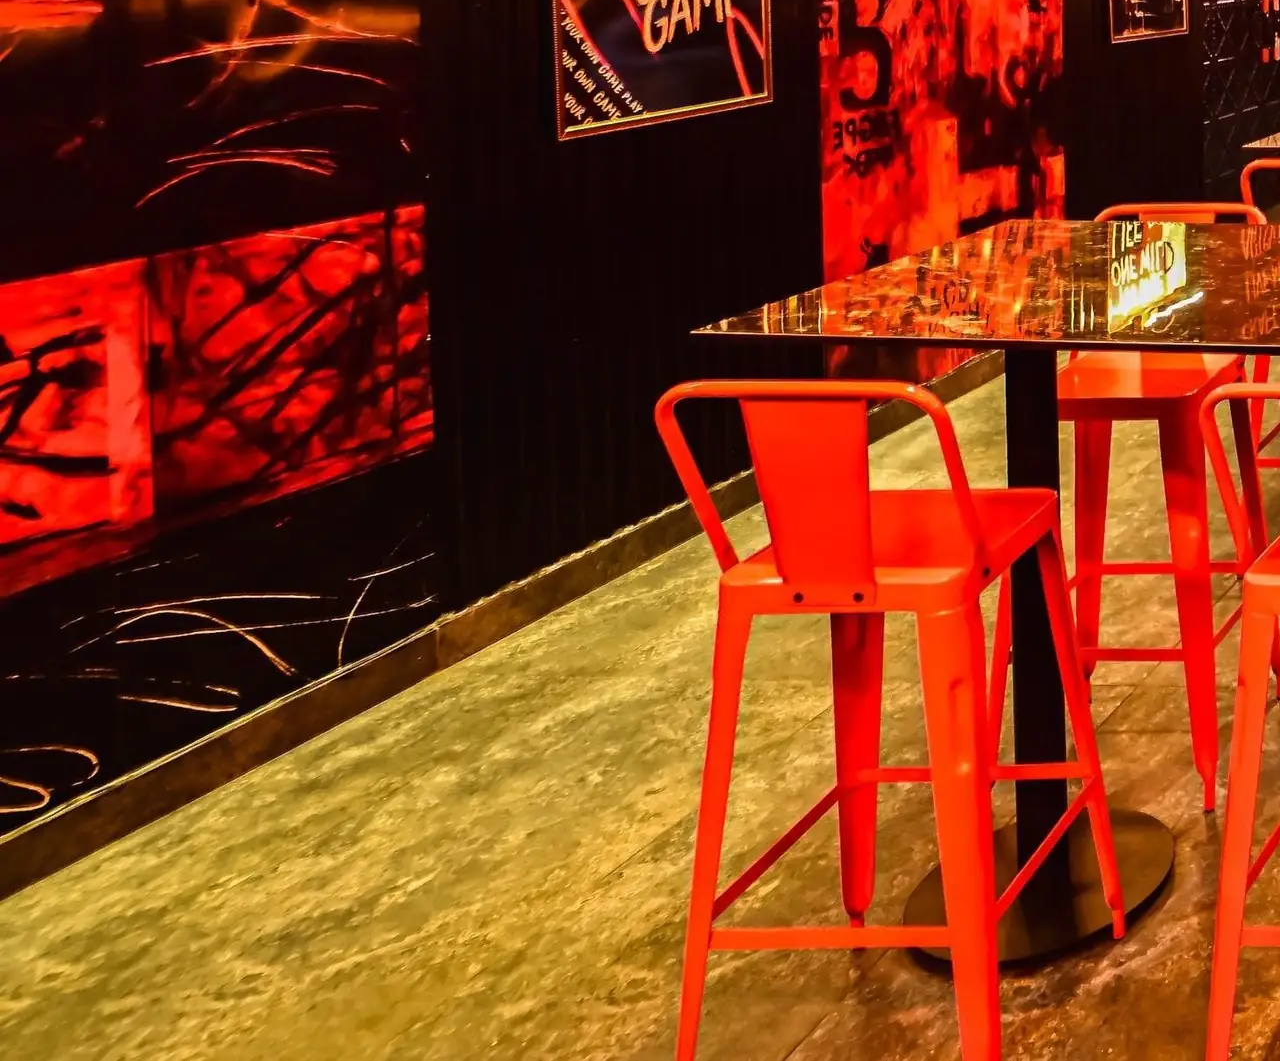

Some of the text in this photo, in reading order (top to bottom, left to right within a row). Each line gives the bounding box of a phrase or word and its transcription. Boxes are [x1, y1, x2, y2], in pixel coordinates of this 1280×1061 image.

[561, 17, 644, 113] YOUR OWN GAME PLAY
[574, 68, 596, 93] OWN
[564, 92, 586, 120] YOUR
